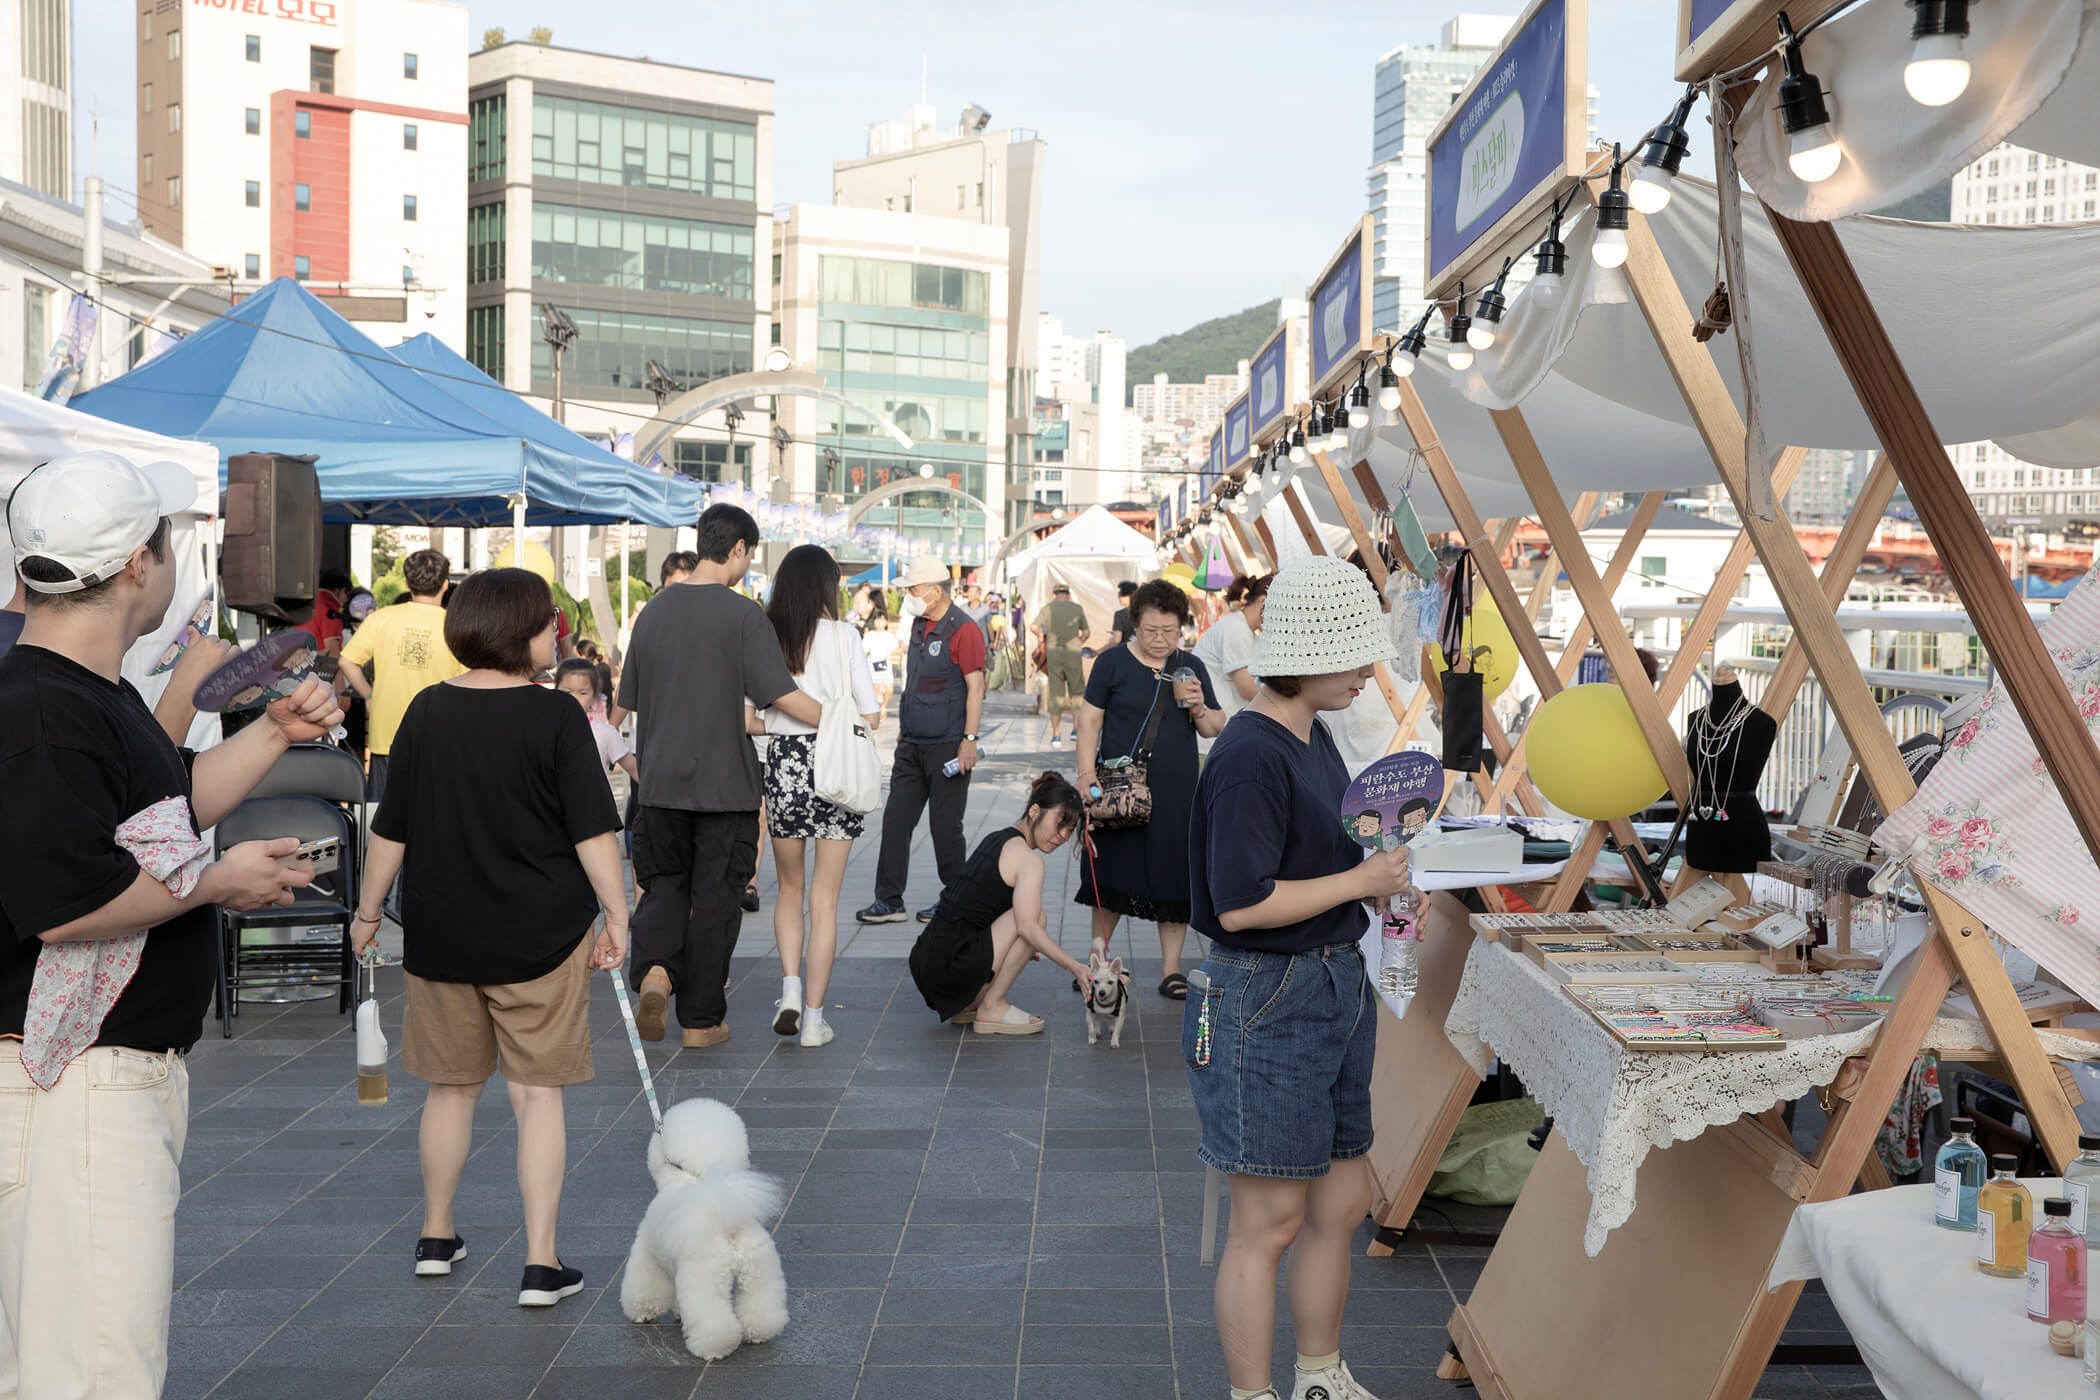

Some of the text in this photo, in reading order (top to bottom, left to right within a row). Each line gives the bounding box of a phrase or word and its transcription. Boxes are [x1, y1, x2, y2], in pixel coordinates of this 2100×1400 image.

[1360, 770, 1407, 785] 피란수도
[1410, 764, 1434, 776] 부산
[1363, 781, 1400, 798] 문화재
[1402, 777, 1427, 790] 야행
